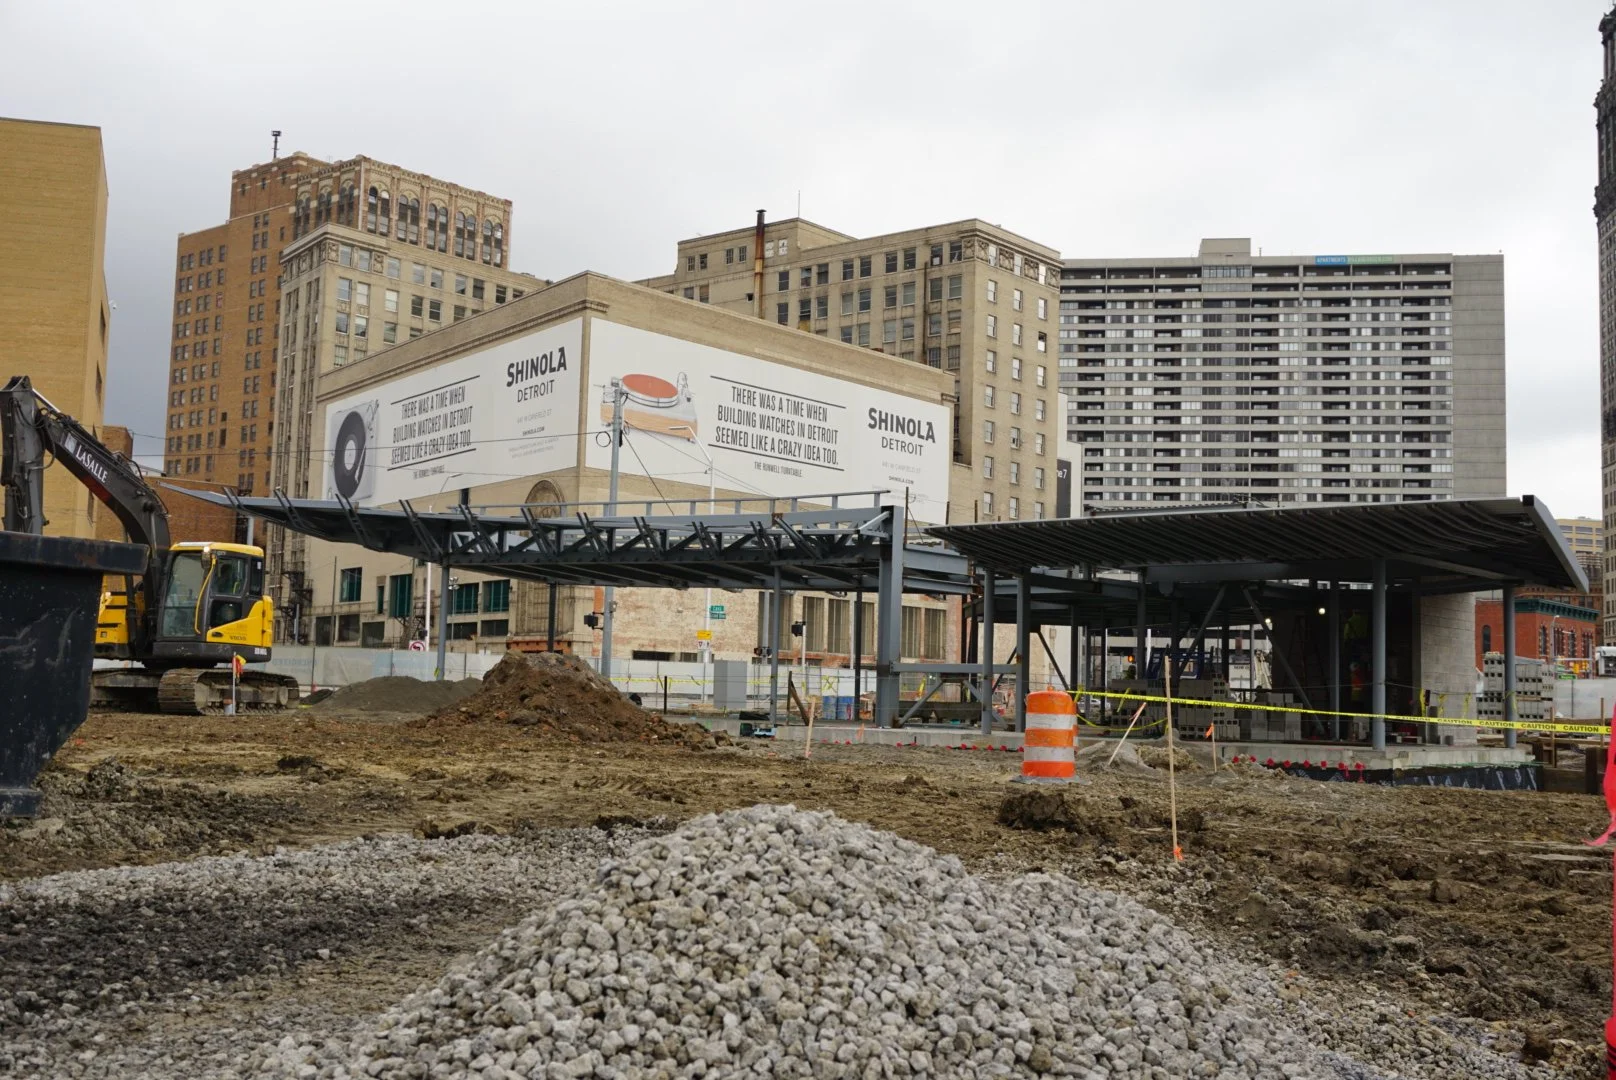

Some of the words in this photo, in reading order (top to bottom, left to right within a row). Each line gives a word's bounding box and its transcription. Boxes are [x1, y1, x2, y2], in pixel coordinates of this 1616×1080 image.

[506, 346, 567, 387] SHINOLA
[402, 400, 417, 420] THERE
[418, 396, 430, 415] WAS
[430, 394, 434, 412] A
[435, 390, 448, 410] TIME
[449, 385, 466, 406] WHEN
[517, 379, 555, 403] DETROIT
[732, 386, 757, 407] THERE
[759, 392, 776, 411] WAS
[778, 396, 783, 413] A
[786, 398, 804, 418] TIME
[806, 403, 828, 422] WHEN
[393, 421, 417, 444] BUILDING
[417, 414, 441, 437] WATCHES
[442, 412, 449, 430] IN
[449, 405, 473, 428] DETROIT
[717, 405, 756, 428] BUILDING
[759, 414, 795, 436] WATCHES
[797, 422, 805, 438] IN
[807, 424, 838, 445] DETROIT
[868, 407, 936, 443] SHINOLA
[391, 445, 411, 465] SEEMED
[412, 441, 424, 460] LIKE
[429, 435, 446, 456] CRAZY
[446, 432, 459, 452] IDEA
[715, 426, 749, 448] SEEMED
[751, 433, 768, 452] LIKE
[770, 437, 775, 453] A
[777, 439, 802, 458] CRAZY
[804, 444, 820, 461] IDEA
[823, 447, 839, 465] TOO.
[881, 436, 924, 456] DETROIT
